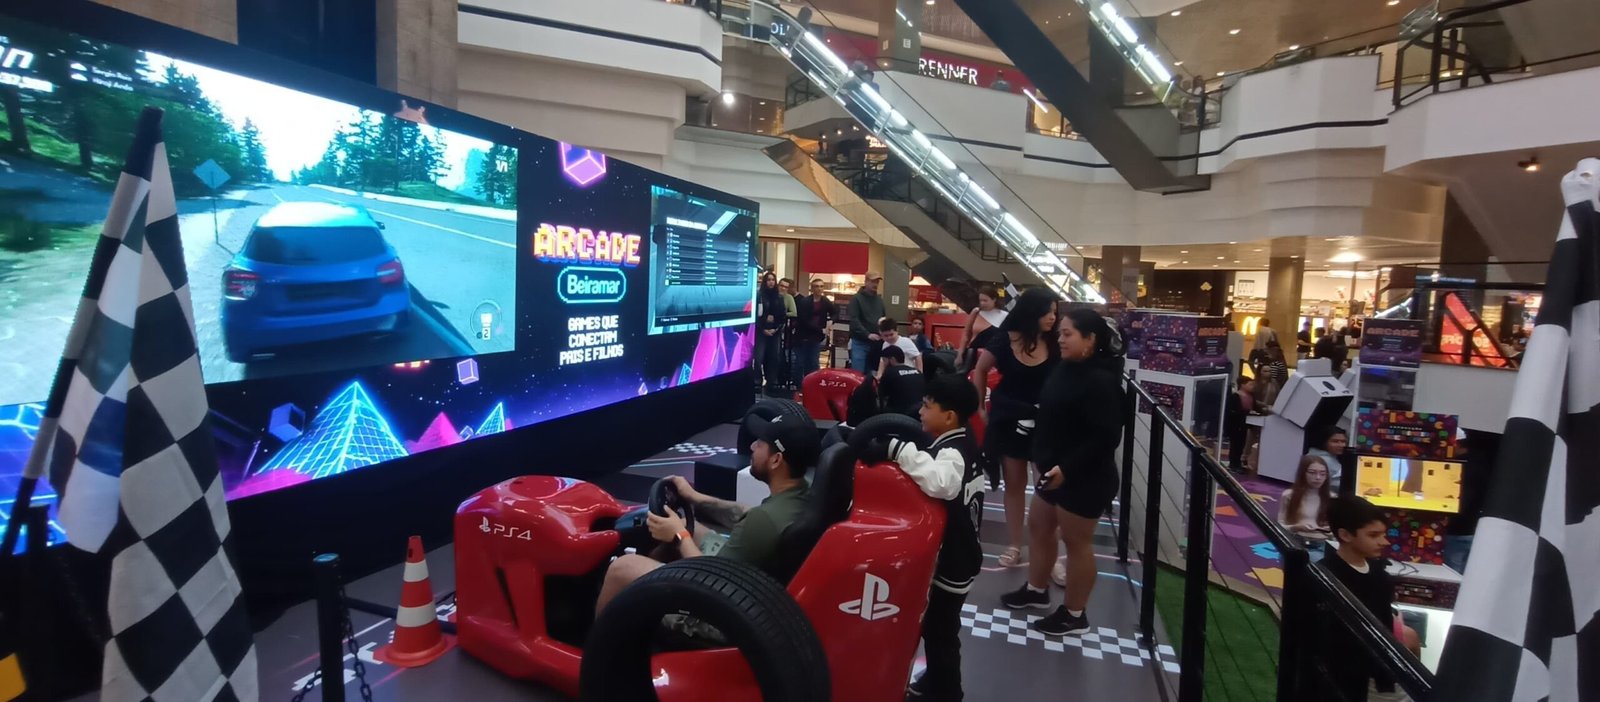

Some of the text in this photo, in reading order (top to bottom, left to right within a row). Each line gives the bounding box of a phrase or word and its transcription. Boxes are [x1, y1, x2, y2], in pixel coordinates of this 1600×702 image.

[919, 57, 978, 85] RENNER
[534, 223, 642, 267] ARCADE
[567, 274, 620, 295] Beiramar
[568, 315, 619, 331] GAMES QUE
[1366, 327, 1420, 337] ARCADE
[568, 330, 618, 348] CONECTAM
[559, 344, 624, 366] PAIS E FILHOS
[493, 523, 532, 541] PS4
